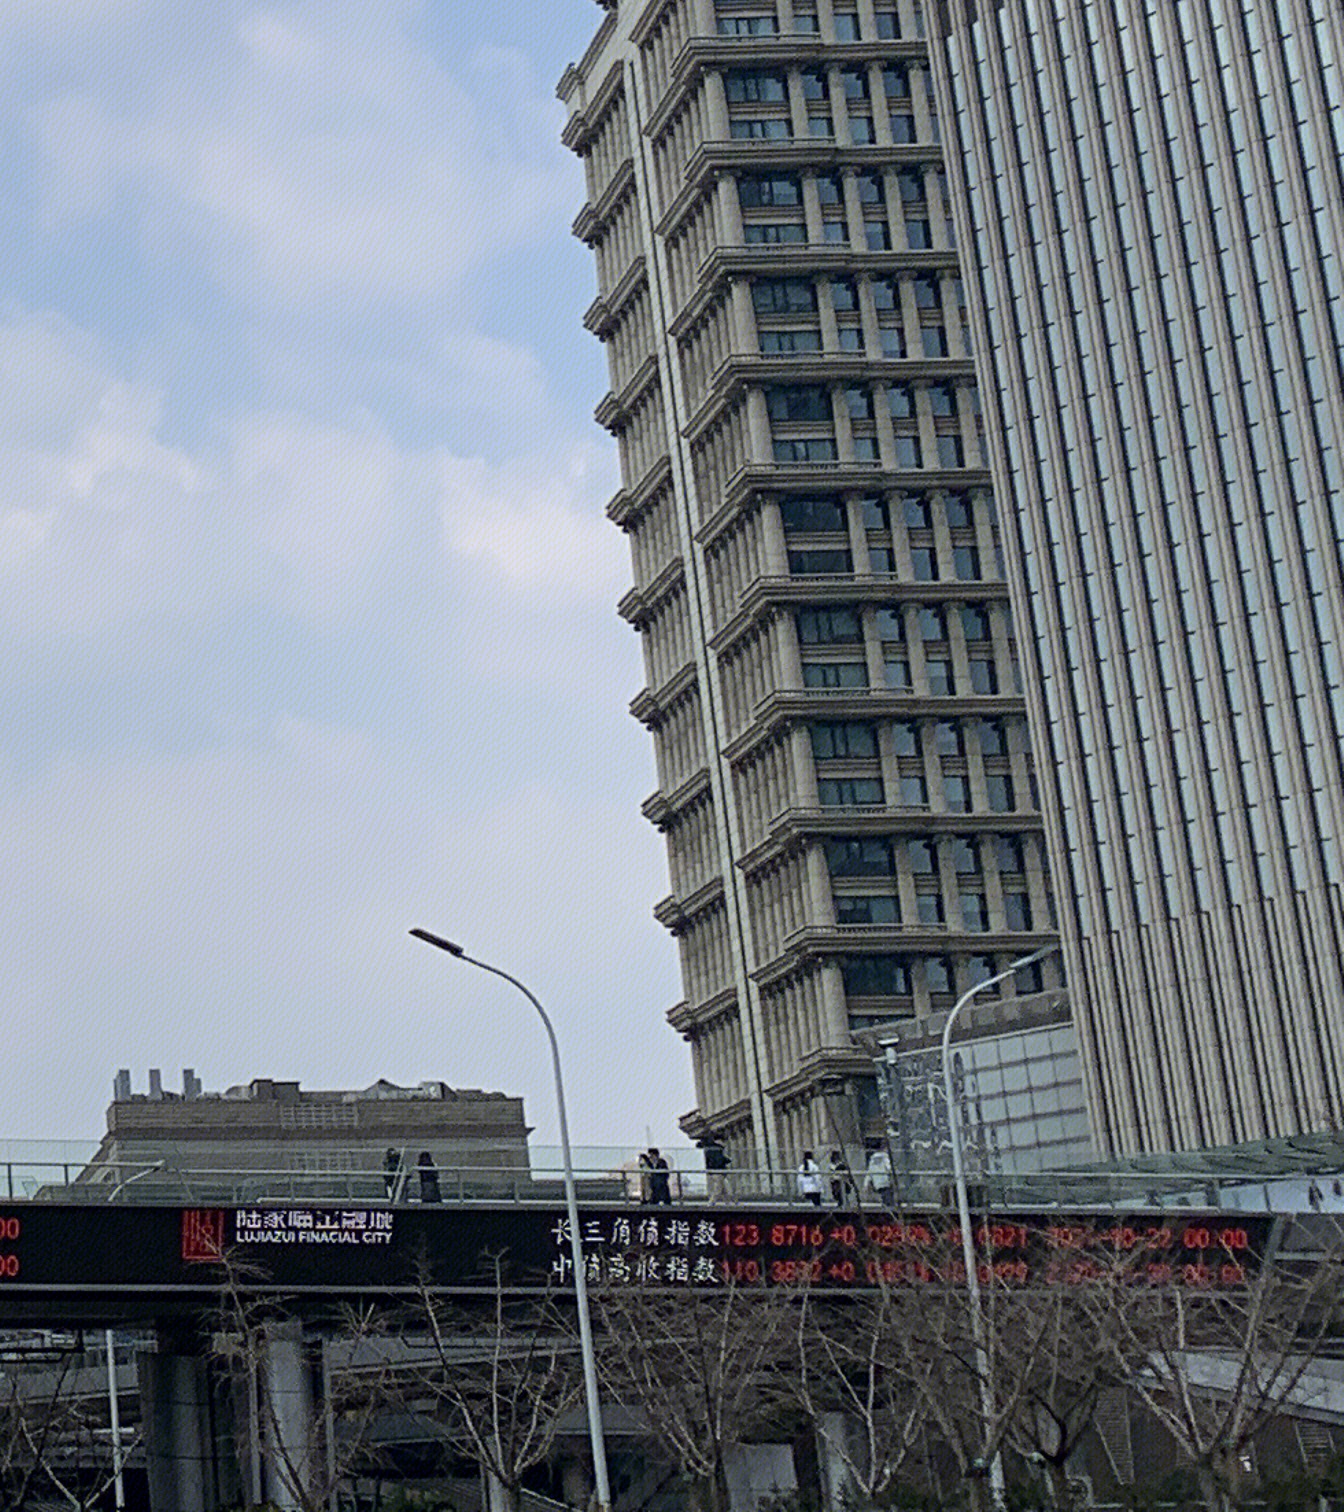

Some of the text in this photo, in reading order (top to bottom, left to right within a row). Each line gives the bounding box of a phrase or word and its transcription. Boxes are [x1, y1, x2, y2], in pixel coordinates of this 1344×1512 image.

[236, 1230, 394, 1244] LUJIAZUI FINACIAL CITY
